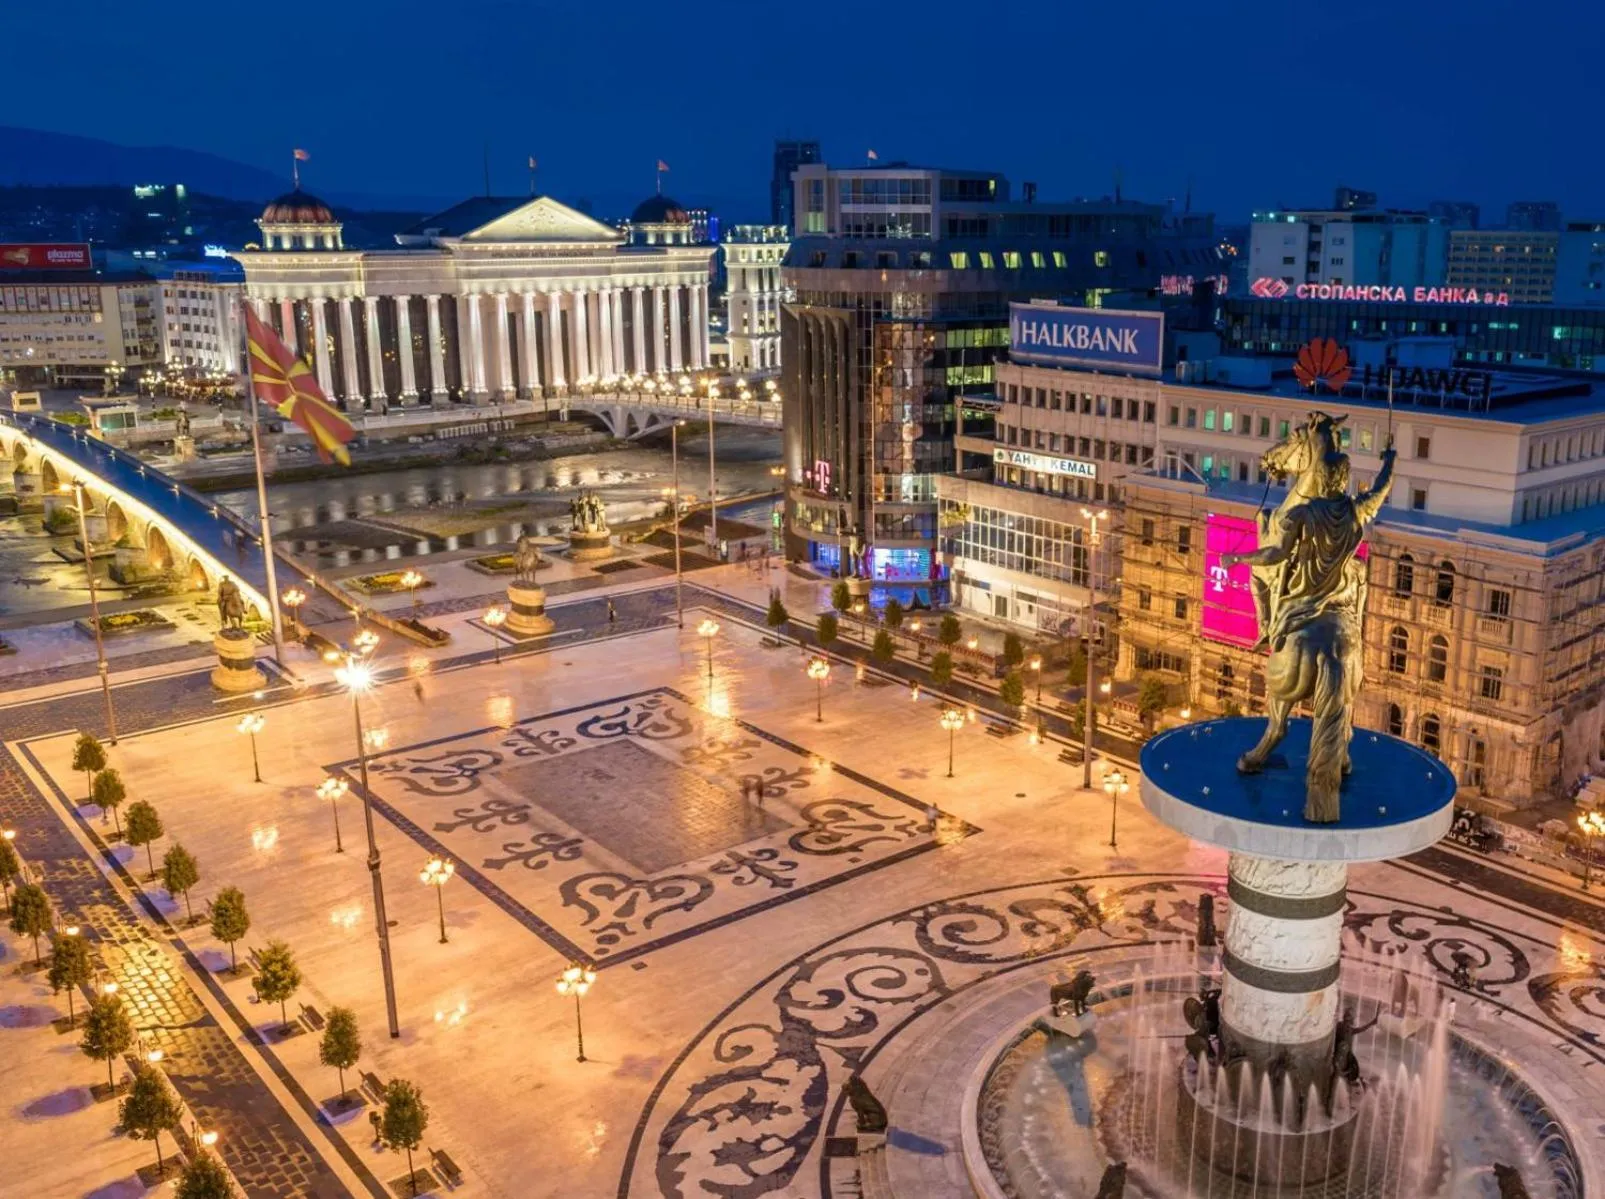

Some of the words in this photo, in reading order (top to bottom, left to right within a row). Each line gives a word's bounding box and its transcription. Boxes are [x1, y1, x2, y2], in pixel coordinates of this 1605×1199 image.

[1296, 284, 1407, 301] СТОПАНСКА
[1414, 287, 1479, 303] БАНКА
[1021, 320, 1139, 355] HALKBANK
[1050, 459, 1094, 476] KEMAL
